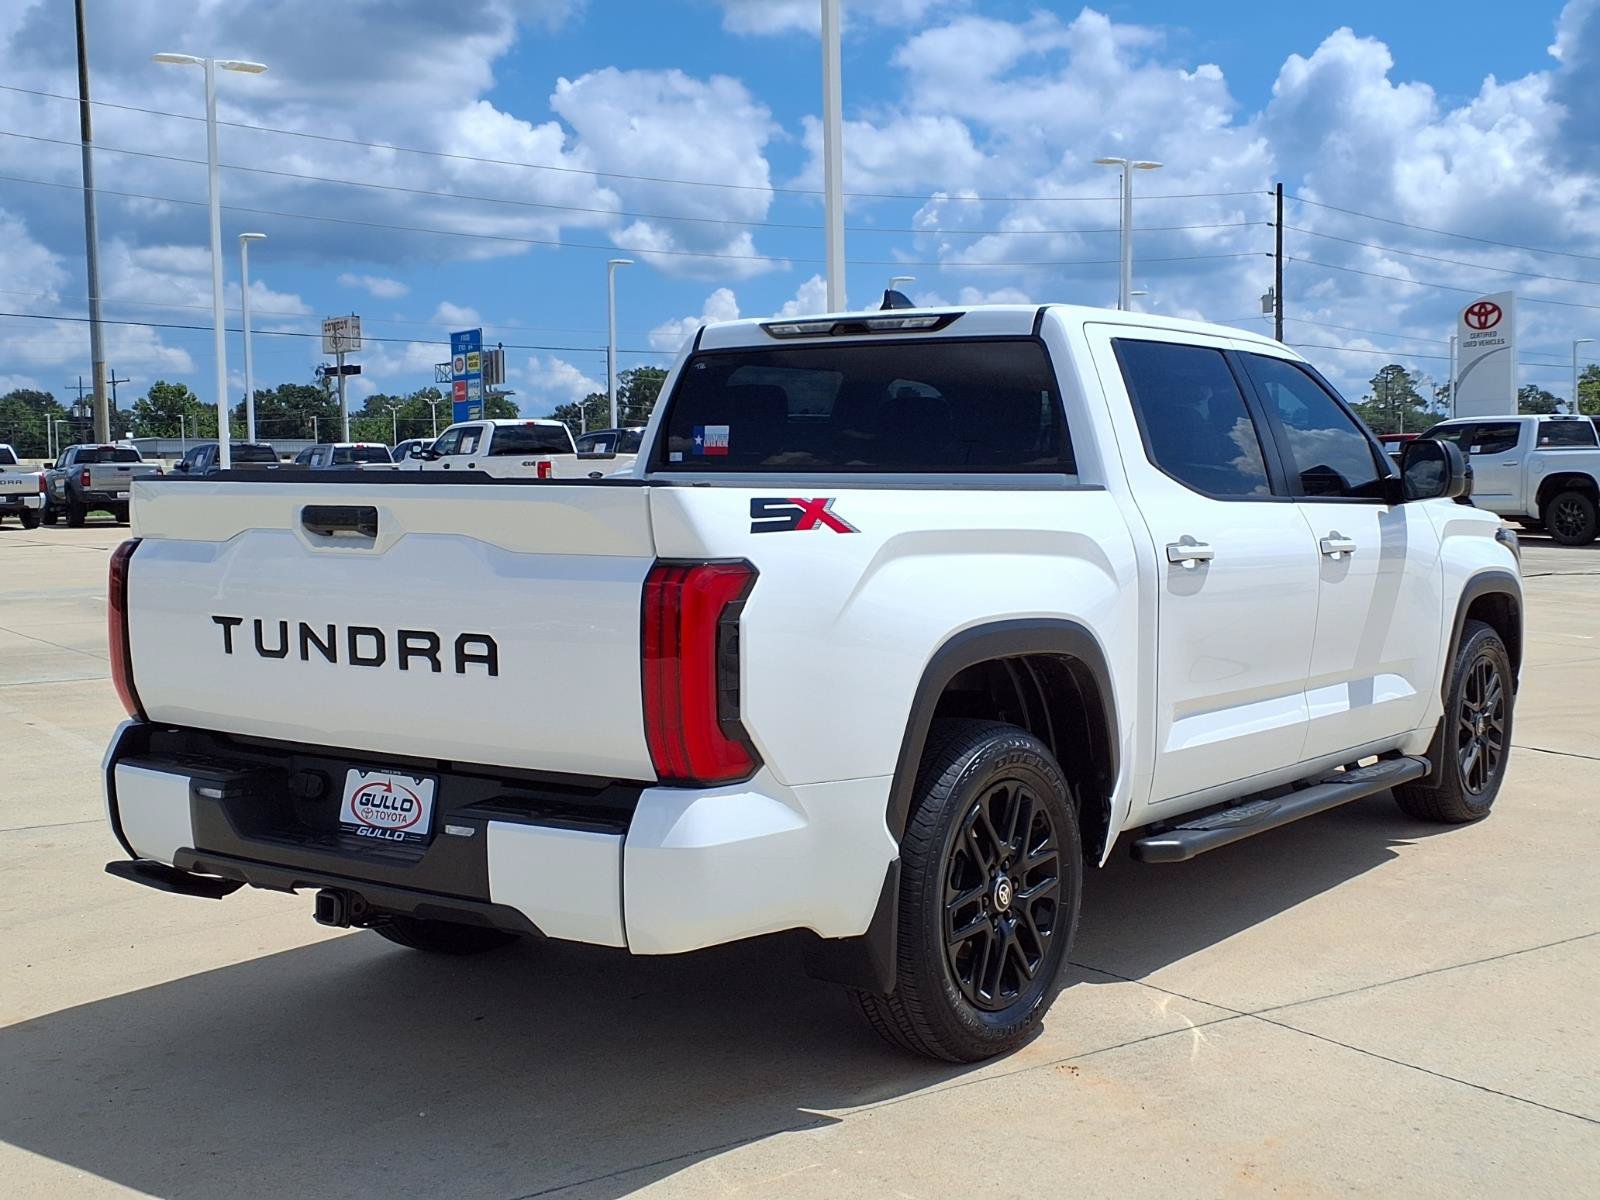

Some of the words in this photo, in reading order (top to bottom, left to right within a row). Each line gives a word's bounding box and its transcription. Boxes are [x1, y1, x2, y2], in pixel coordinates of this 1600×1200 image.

[1470, 331, 1497, 339] CERTIFIED
[1479, 338, 1505, 346] VEHICLES
[211, 615, 499, 677] TUNDRA
[359, 792, 414, 812] GULLO
[375, 810, 408, 824] TOYOTA
[356, 826, 405, 841] GULLO
